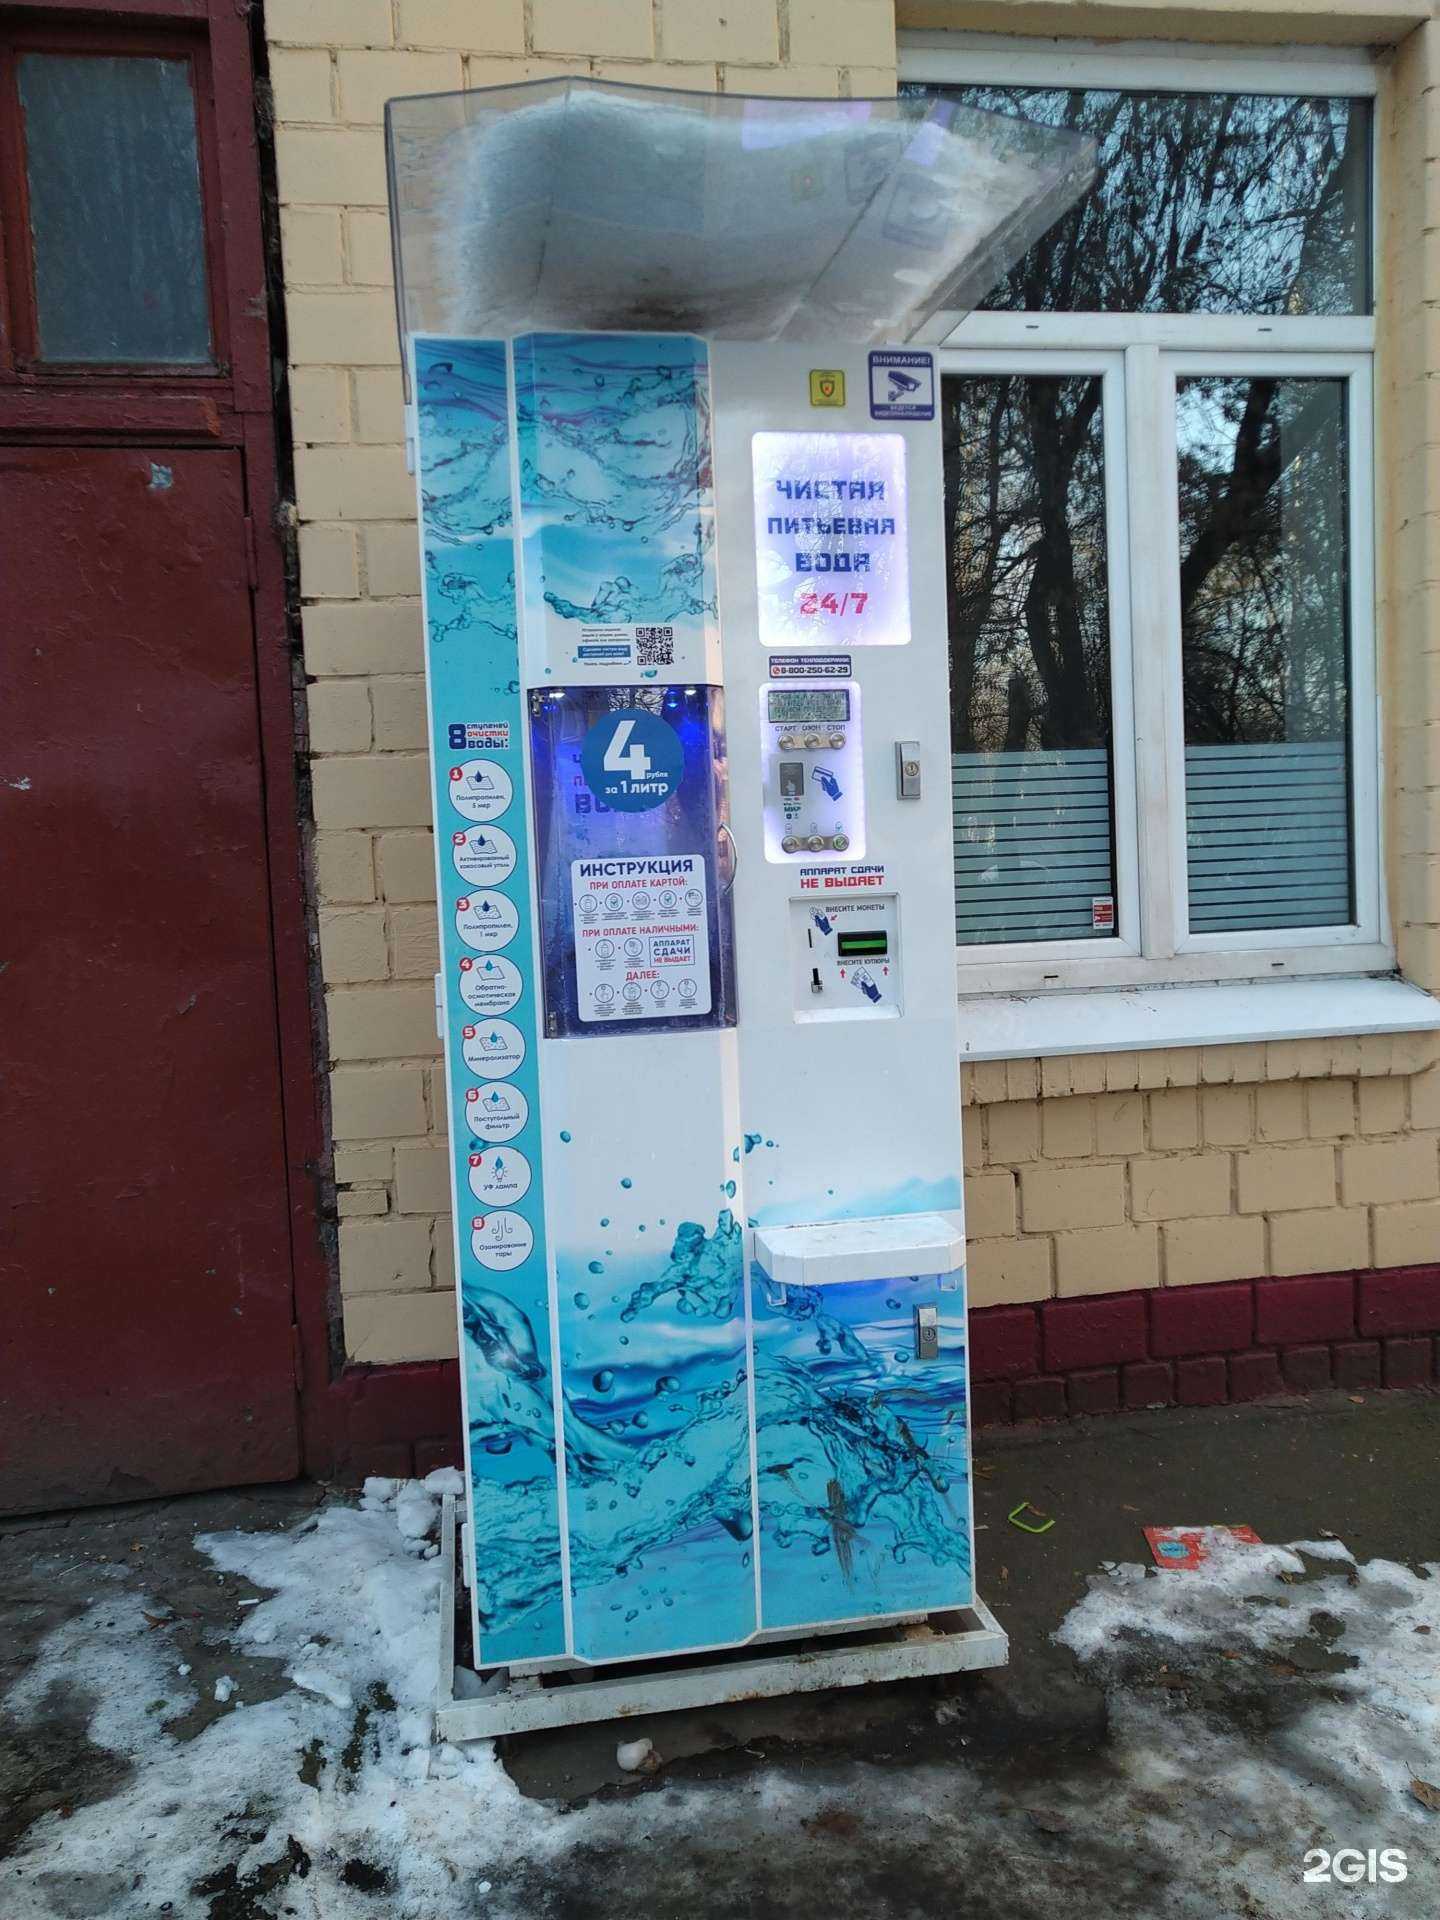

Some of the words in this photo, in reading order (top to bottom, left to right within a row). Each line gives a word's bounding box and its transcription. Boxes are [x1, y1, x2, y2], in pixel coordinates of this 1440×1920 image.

[873, 356, 931, 366] ВНИМАНИЕ!
[777, 480, 885, 500] ЧИСТАЯ
[768, 517, 895, 535] ПИТЬЕВАЯ
[796, 553, 871, 572] ВОДА
[801, 592, 868, 616] 24/7
[781, 666, 848, 674] 8-800-250-62-29
[467, 722, 509, 731] ступеней
[448, 723, 467, 750] 8
[468, 730, 509, 738] очистки
[468, 737, 508, 749] воды:
[603, 720, 651, 780] 4
[452, 769, 461, 779] 1
[646, 770, 669, 779] рубля
[605, 786, 619, 794] за
[620, 780, 628, 794] 1
[630, 783, 669, 796] литр
[454, 834, 464, 844] 2
[580, 860, 694, 877] ИНСТРУКЦИЯ
[800, 867, 847, 876] АППАРАТ
[851, 865, 885, 874] СДАЧИ
[590, 881, 609, 891] ПРИ
[612, 879, 648, 889] ОПЛАТЕ
[650, 876, 688, 888] КАРТОЙ:
[800, 878, 819, 889] НЕ
[824, 875, 885, 888] ВЫДАЕТ
[458, 900, 467, 910] 3
[825, 905, 855, 913] ВНЕСИТЕ
[856, 904, 885, 912] МОНЕТЫ
[582, 929, 601, 938] ПРИ
[603, 926, 638, 937] ОПЛАТЕ
[640, 924, 698, 935] НАЛИЧНЫМИ:
[653, 938, 691, 948] АППАРАТ
[653, 947, 692, 957] СДАЧИ
[461, 960, 471, 970] 4
[865, 957, 891, 965] КУПЮРЫ
[626, 970, 661, 981] ДАЛЕЕ:
[464, 1028, 474, 1037] 5
[468, 1054, 521, 1062] Минерализатор
[468, 1091, 476, 1100] 6
[471, 1156, 480, 1165] 7
[474, 1219, 483, 1228] 8
